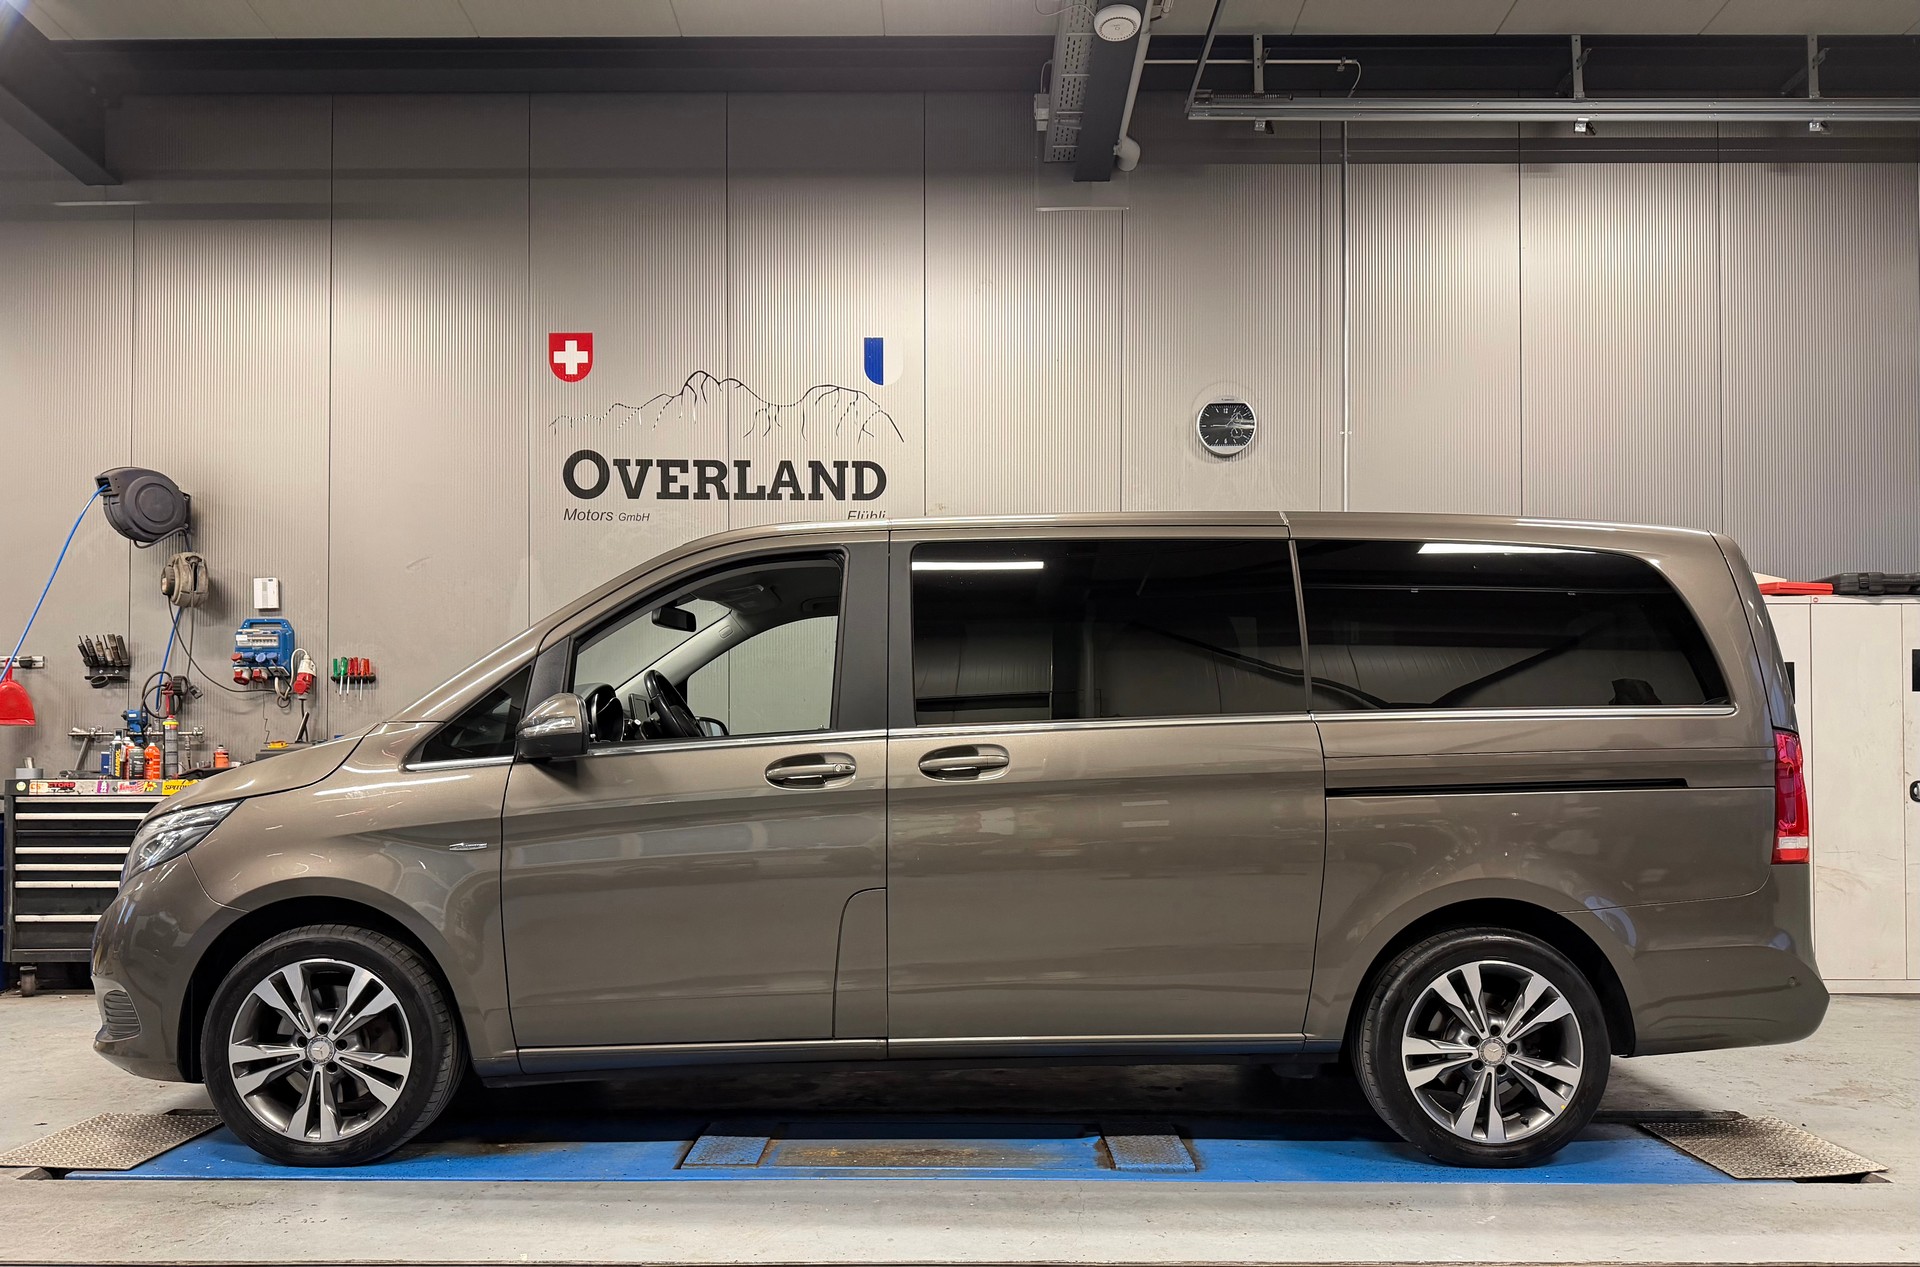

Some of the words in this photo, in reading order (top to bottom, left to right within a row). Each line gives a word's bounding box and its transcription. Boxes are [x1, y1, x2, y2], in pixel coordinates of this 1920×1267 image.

[563, 449, 887, 501] OVERLAND
[563, 508, 613, 521] Motors
[618, 512, 650, 522] GmbH
